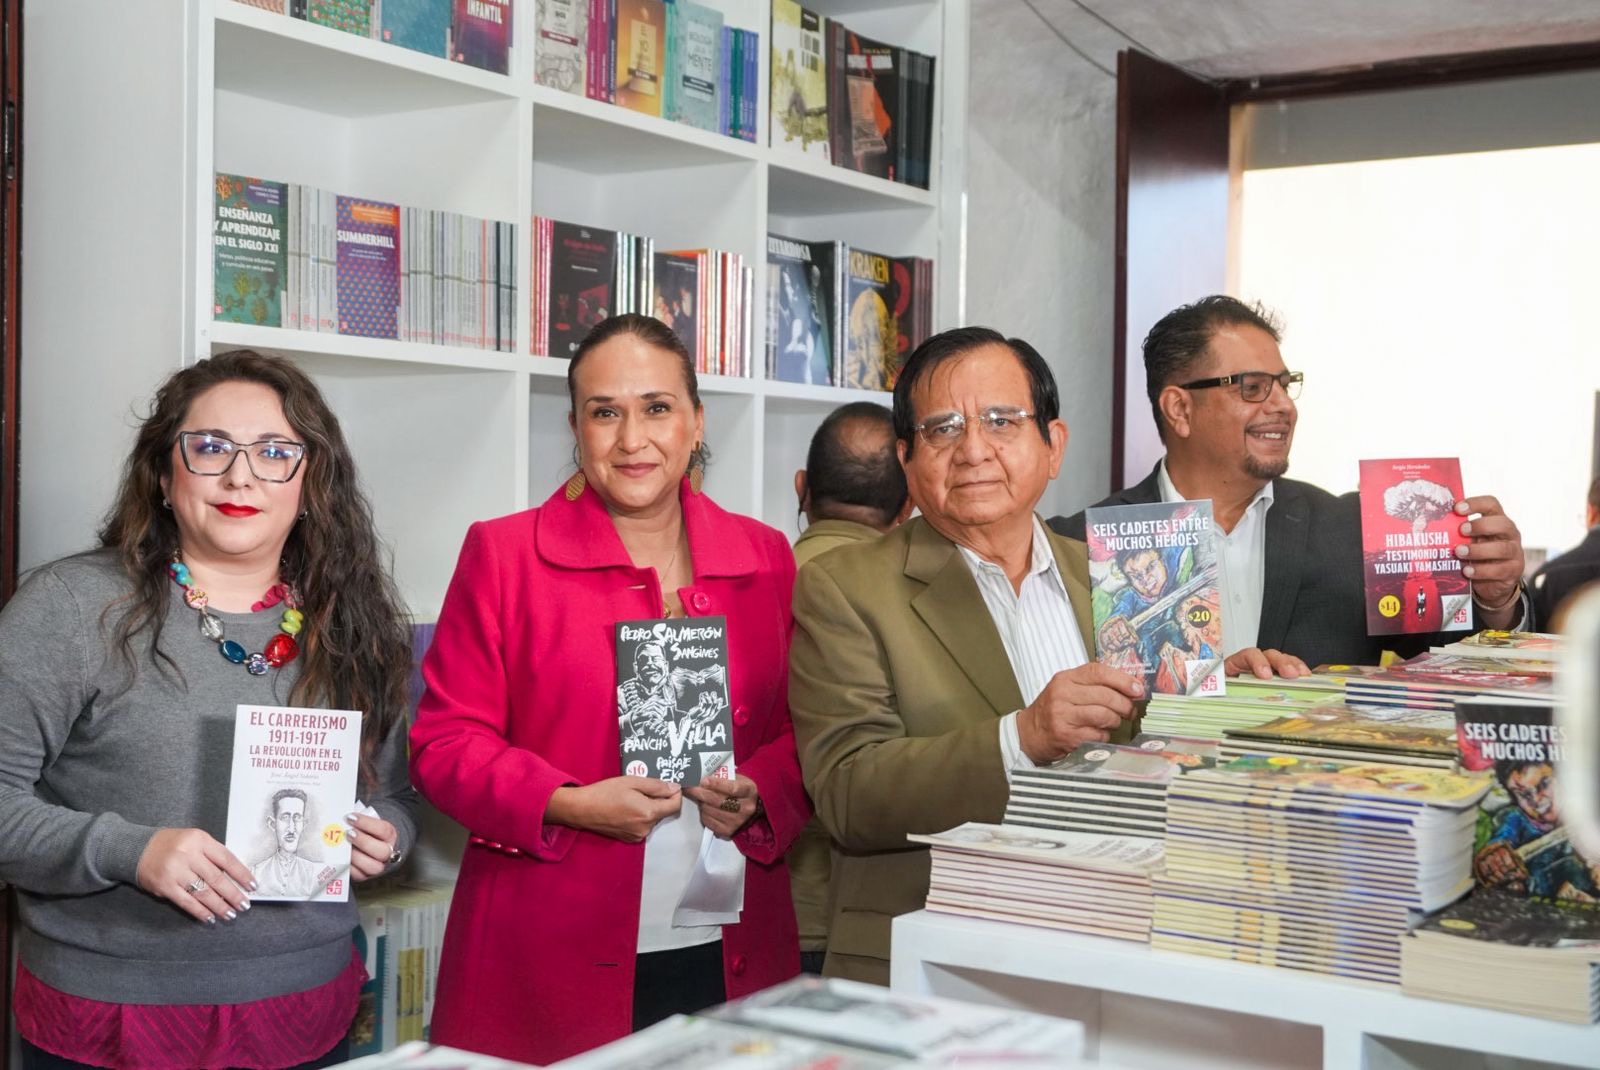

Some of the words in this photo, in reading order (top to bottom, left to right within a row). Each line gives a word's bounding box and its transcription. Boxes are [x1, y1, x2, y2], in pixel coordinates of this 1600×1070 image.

[467, 0, 503, 24] INFANTIL
[219, 206, 274, 225] ENSEÑANZA
[221, 221, 281, 241] APRENDIZAJE
[337, 229, 395, 249] SUMMERHILL
[215, 235, 227, 246] EN
[228, 237, 238, 248] EL
[239, 238, 263, 251] SIGLO
[264, 241, 279, 253] XXI
[849, 251, 889, 284] KRAKEN
[1093, 522, 1118, 538] SEIS
[1119, 520, 1169, 536] CADETES
[1170, 516, 1209, 532] ENTRE
[1105, 535, 1153, 551] MUCHOS
[1385, 531, 1450, 547] HIBAKUSHA
[1385, 548, 1438, 561] TESTIMONIO
[1439, 548, 1450, 559] DE
[1374, 562, 1413, 574] YASUAKI
[1415, 559, 1461, 572] YAMASHITA
[1188, 610, 1209, 623] $20
[620, 625, 651, 642] PEDRO
[250, 711, 264, 726] EL
[268, 712, 347, 731] CARRERISMO
[269, 729, 327, 745] 1911-1917
[1464, 722, 1497, 740] SEIS
[1499, 723, 1567, 742] CADETES
[249, 745, 260, 755] LA
[319, 748, 330, 759] EN
[332, 749, 343, 759] EL
[624, 736, 668, 753] PANCHO
[1481, 742, 1545, 761] MUCHOS
[303, 760, 340, 771] IXTLERO
[324, 830, 342, 843] $17
